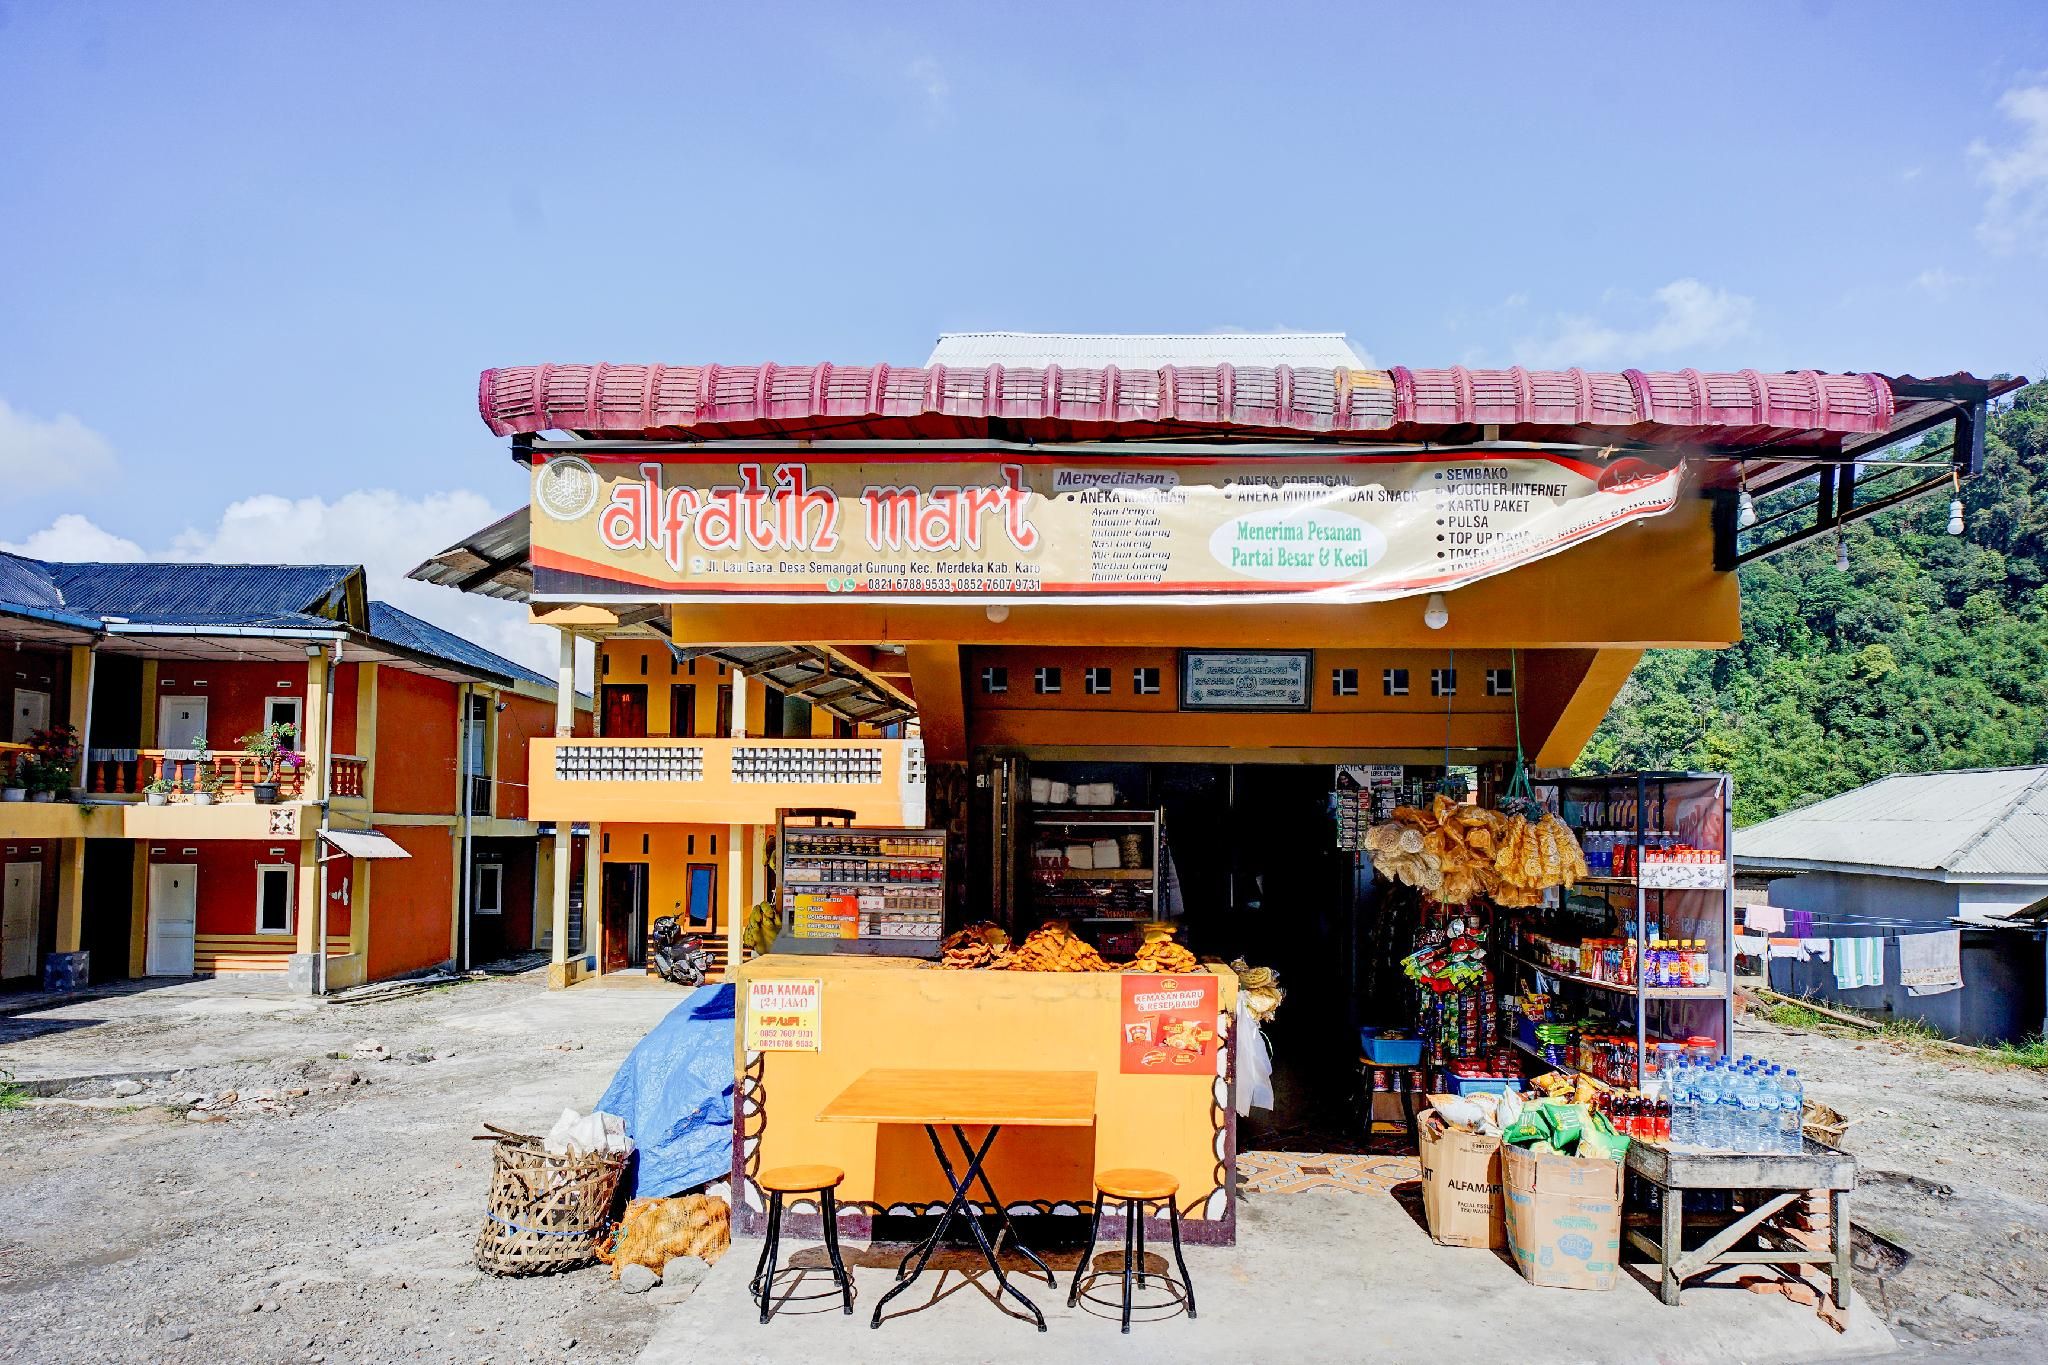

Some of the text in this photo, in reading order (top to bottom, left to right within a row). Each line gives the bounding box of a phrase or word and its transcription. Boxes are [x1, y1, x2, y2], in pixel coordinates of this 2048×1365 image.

[1058, 471, 1165, 487] Menyediakan
[1447, 468, 1508, 480] SEMBAKO
[1238, 475, 1279, 487] ANEKA
[1447, 482, 1568, 497] VOUCHER INTERNET
[1081, 492, 1120, 503] ANEKA
[1238, 491, 1279, 502] ANEKA
[1378, 490, 1420, 502] SNACK
[1448, 500, 1530, 513] KARTU PAKET
[600, 464, 838, 569] alfatih
[863, 464, 1040, 552] mart
[1448, 515, 1488, 528] PULSA
[1237, 521, 1362, 541] Menerima Pesanan
[1448, 532, 1472, 544] TOP
[1476, 532, 1492, 544] UP
[1232, 547, 1273, 566] Partai
[1278, 547, 1315, 566] Besar
[1334, 548, 1368, 566] Kecil
[706, 561, 718, 572] Jl.
[723, 561, 742, 573] Lau
[779, 562, 805, 573] Desa
[809, 562, 863, 575] Semangat
[866, 562, 906, 575] Gunung
[910, 562, 932, 573] Kec.
[937, 562, 983, 573] Merdeka
[987, 562, 1010, 573] Kab.
[1015, 562, 1040, 573] Karo
[868, 579, 892, 590] 0821
[896, 579, 921, 590] 6788
[957, 579, 983, 590] 0852
[986, 579, 1012, 590] 7607
[1015, 579, 1041, 590] 9731
[753, 985, 815, 996] ADA KAMAR
[1136, 991, 1203, 1003] KEMASAN BARU
[780, 998, 807, 1009] JAM)
